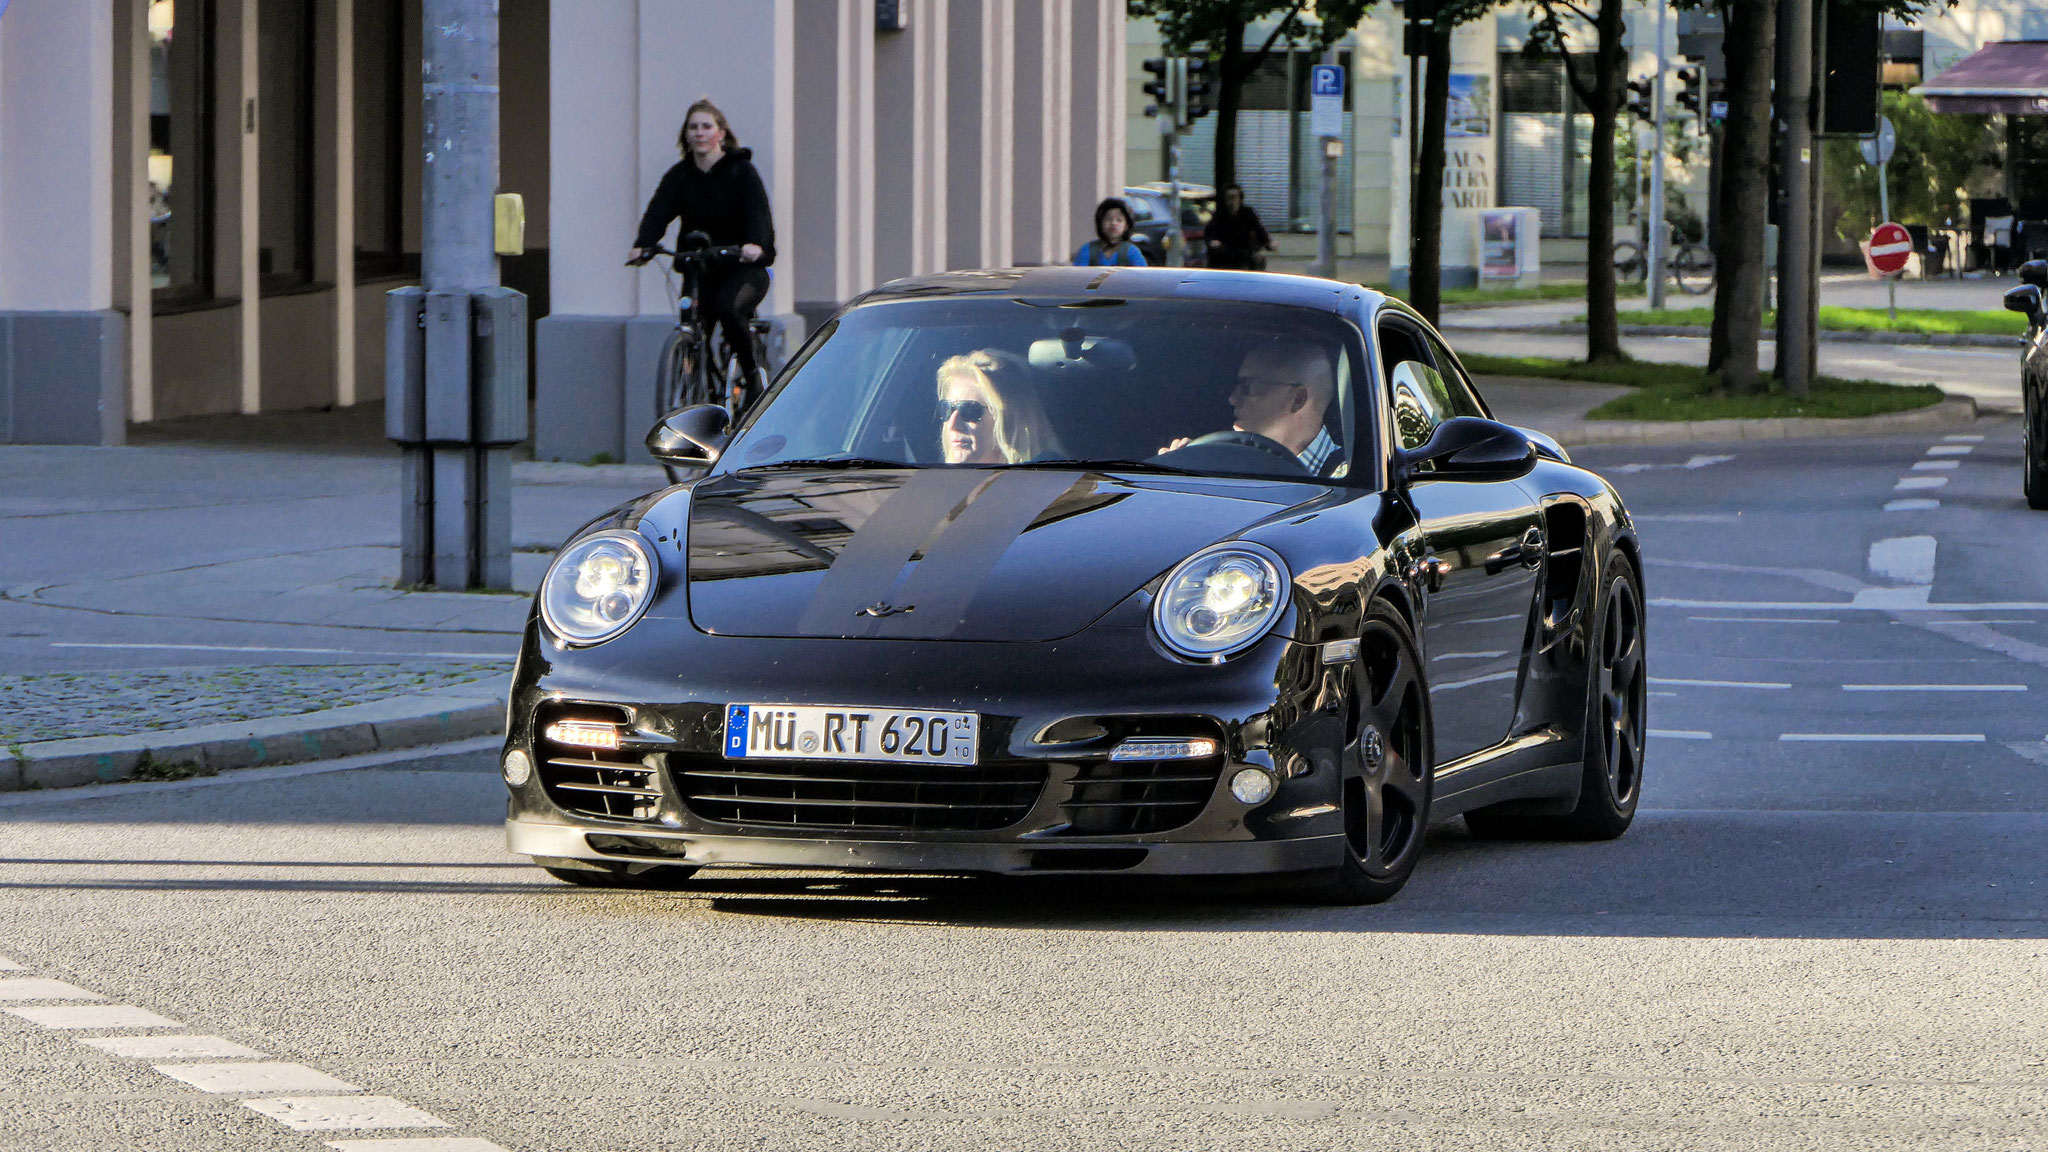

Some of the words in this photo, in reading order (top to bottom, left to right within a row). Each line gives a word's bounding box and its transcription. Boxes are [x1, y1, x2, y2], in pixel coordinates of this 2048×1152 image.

[1316, 69, 1336, 92] P
[1444, 151, 1486, 168] AUS
[731, 736, 741, 748] D
[823, 712, 870, 753] RT
[880, 715, 948, 757] 620
[954, 746, 969, 758] 10
